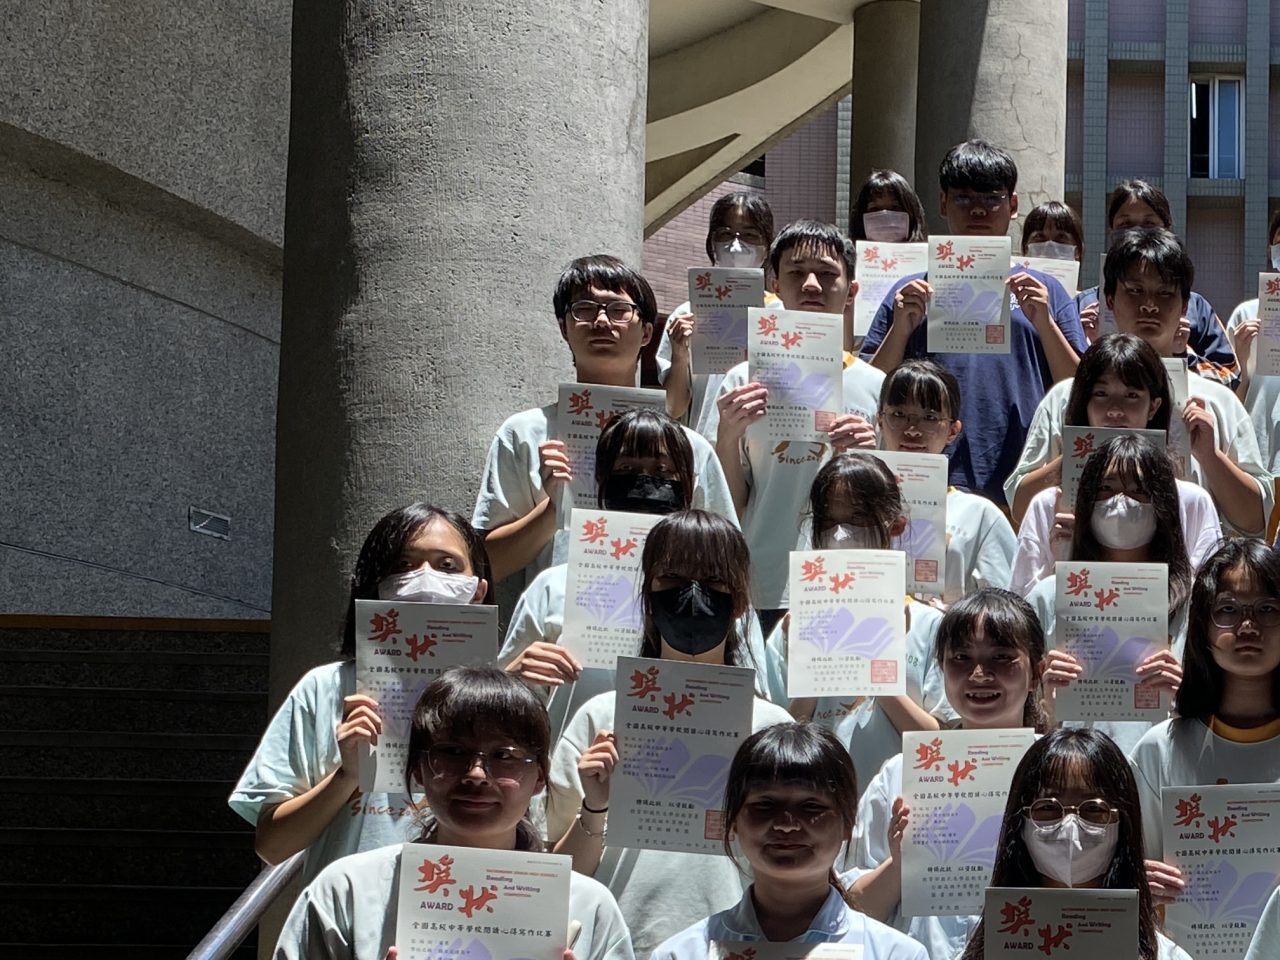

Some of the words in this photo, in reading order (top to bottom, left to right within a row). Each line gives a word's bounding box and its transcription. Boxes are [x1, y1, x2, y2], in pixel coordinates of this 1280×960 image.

[756, 313, 802, 350] 獎狀
[579, 516, 637, 560] 獎狀
[799, 557, 856, 596] 獎狀
[1065, 567, 1119, 611] 獎狀
[368, 608, 437, 662] 獎狀
[374, 648, 402, 657] AWARD
[627, 666, 694, 720] 獎狀
[632, 705, 659, 714] AWARD
[913, 737, 977, 787] 獎狀
[1173, 793, 1237, 843] 獎狀
[414, 854, 497, 918] 獎狀
[486, 875, 513, 884] Reading
[420, 901, 454, 911] AWARD
[997, 896, 1072, 955] 獎狀
[1004, 942, 1034, 950] AWARD
